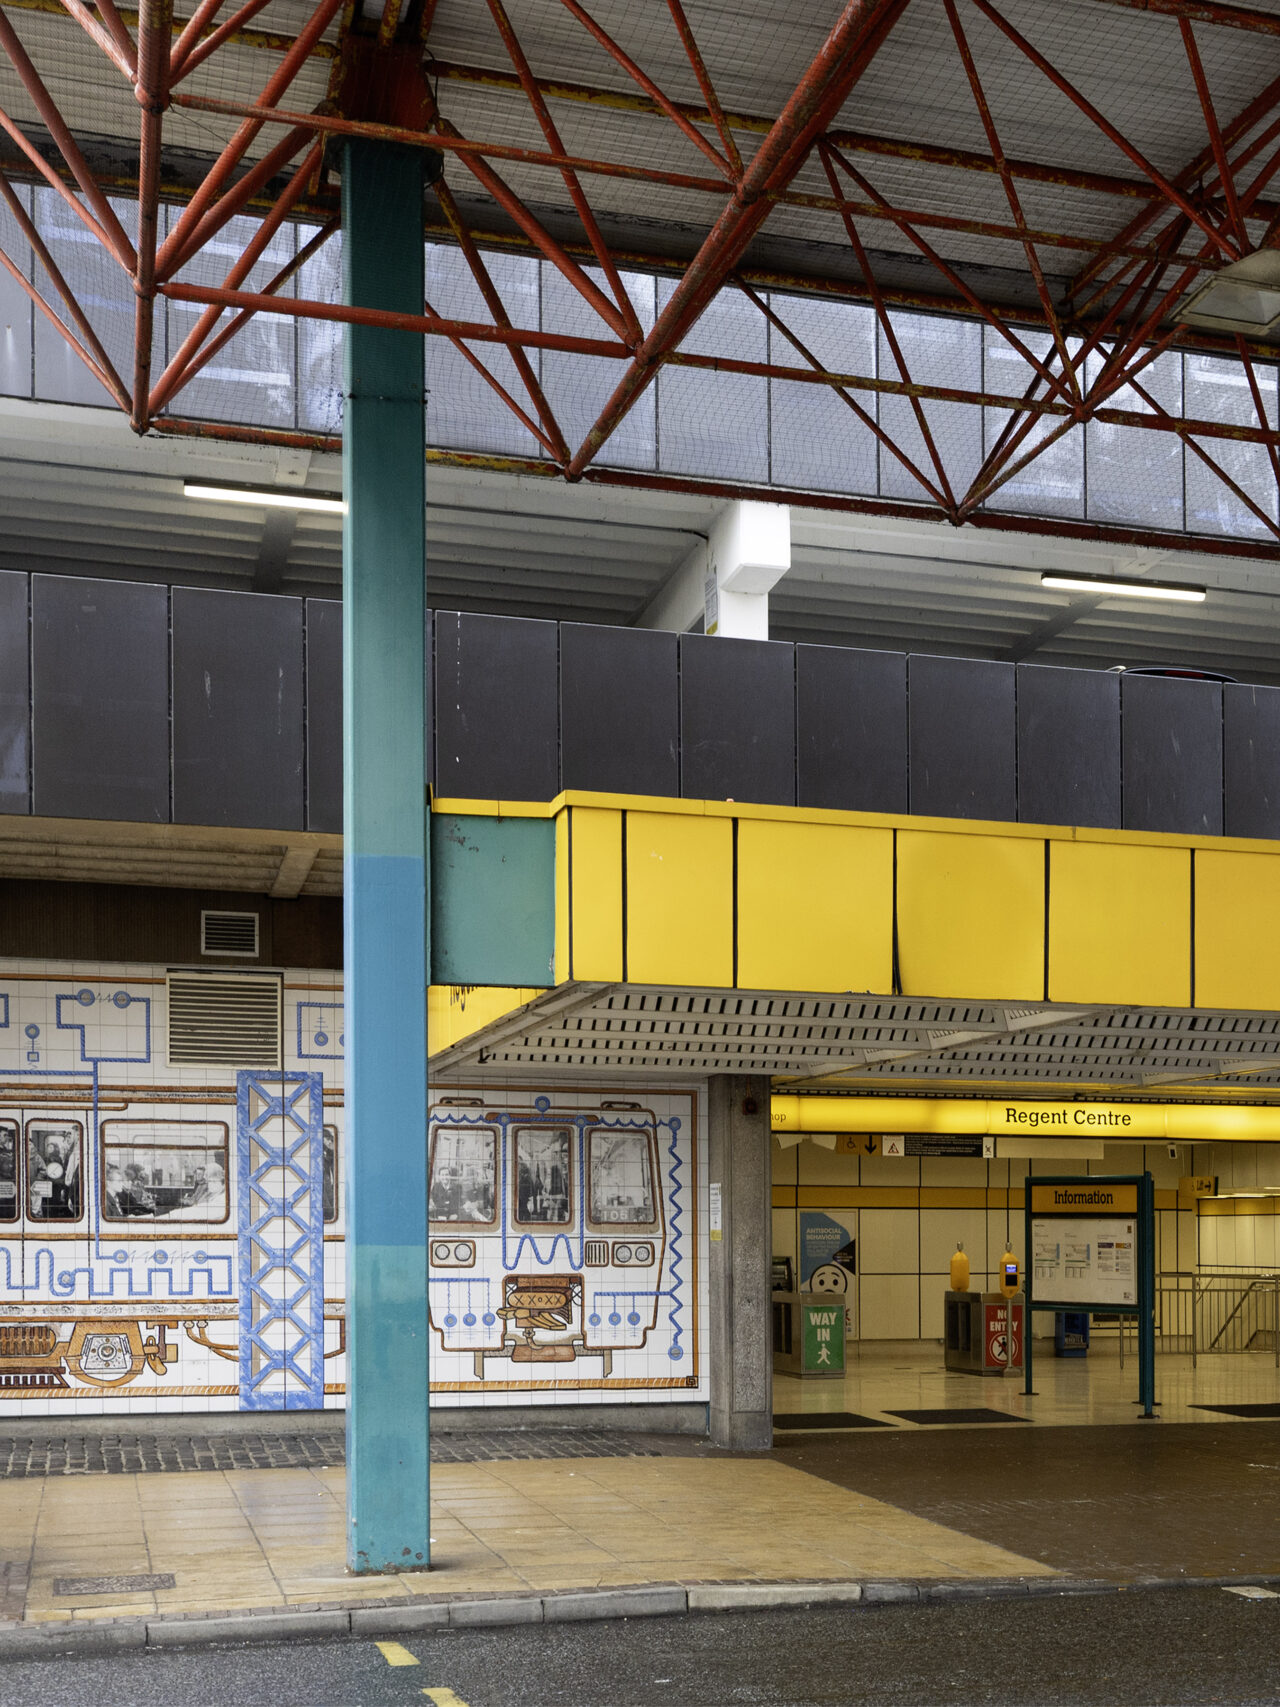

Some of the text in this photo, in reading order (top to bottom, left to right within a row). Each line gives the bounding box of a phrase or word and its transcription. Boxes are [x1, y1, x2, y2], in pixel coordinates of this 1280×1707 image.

[1005, 1108, 1132, 1127] Regent Centre
[1054, 1190, 1114, 1205] Information
[806, 1227, 843, 1235] ANTISOCIAL
[809, 1312, 838, 1326] WAY
[989, 1321, 1018, 1332] ENTY
[817, 1328, 831, 1342] IN
